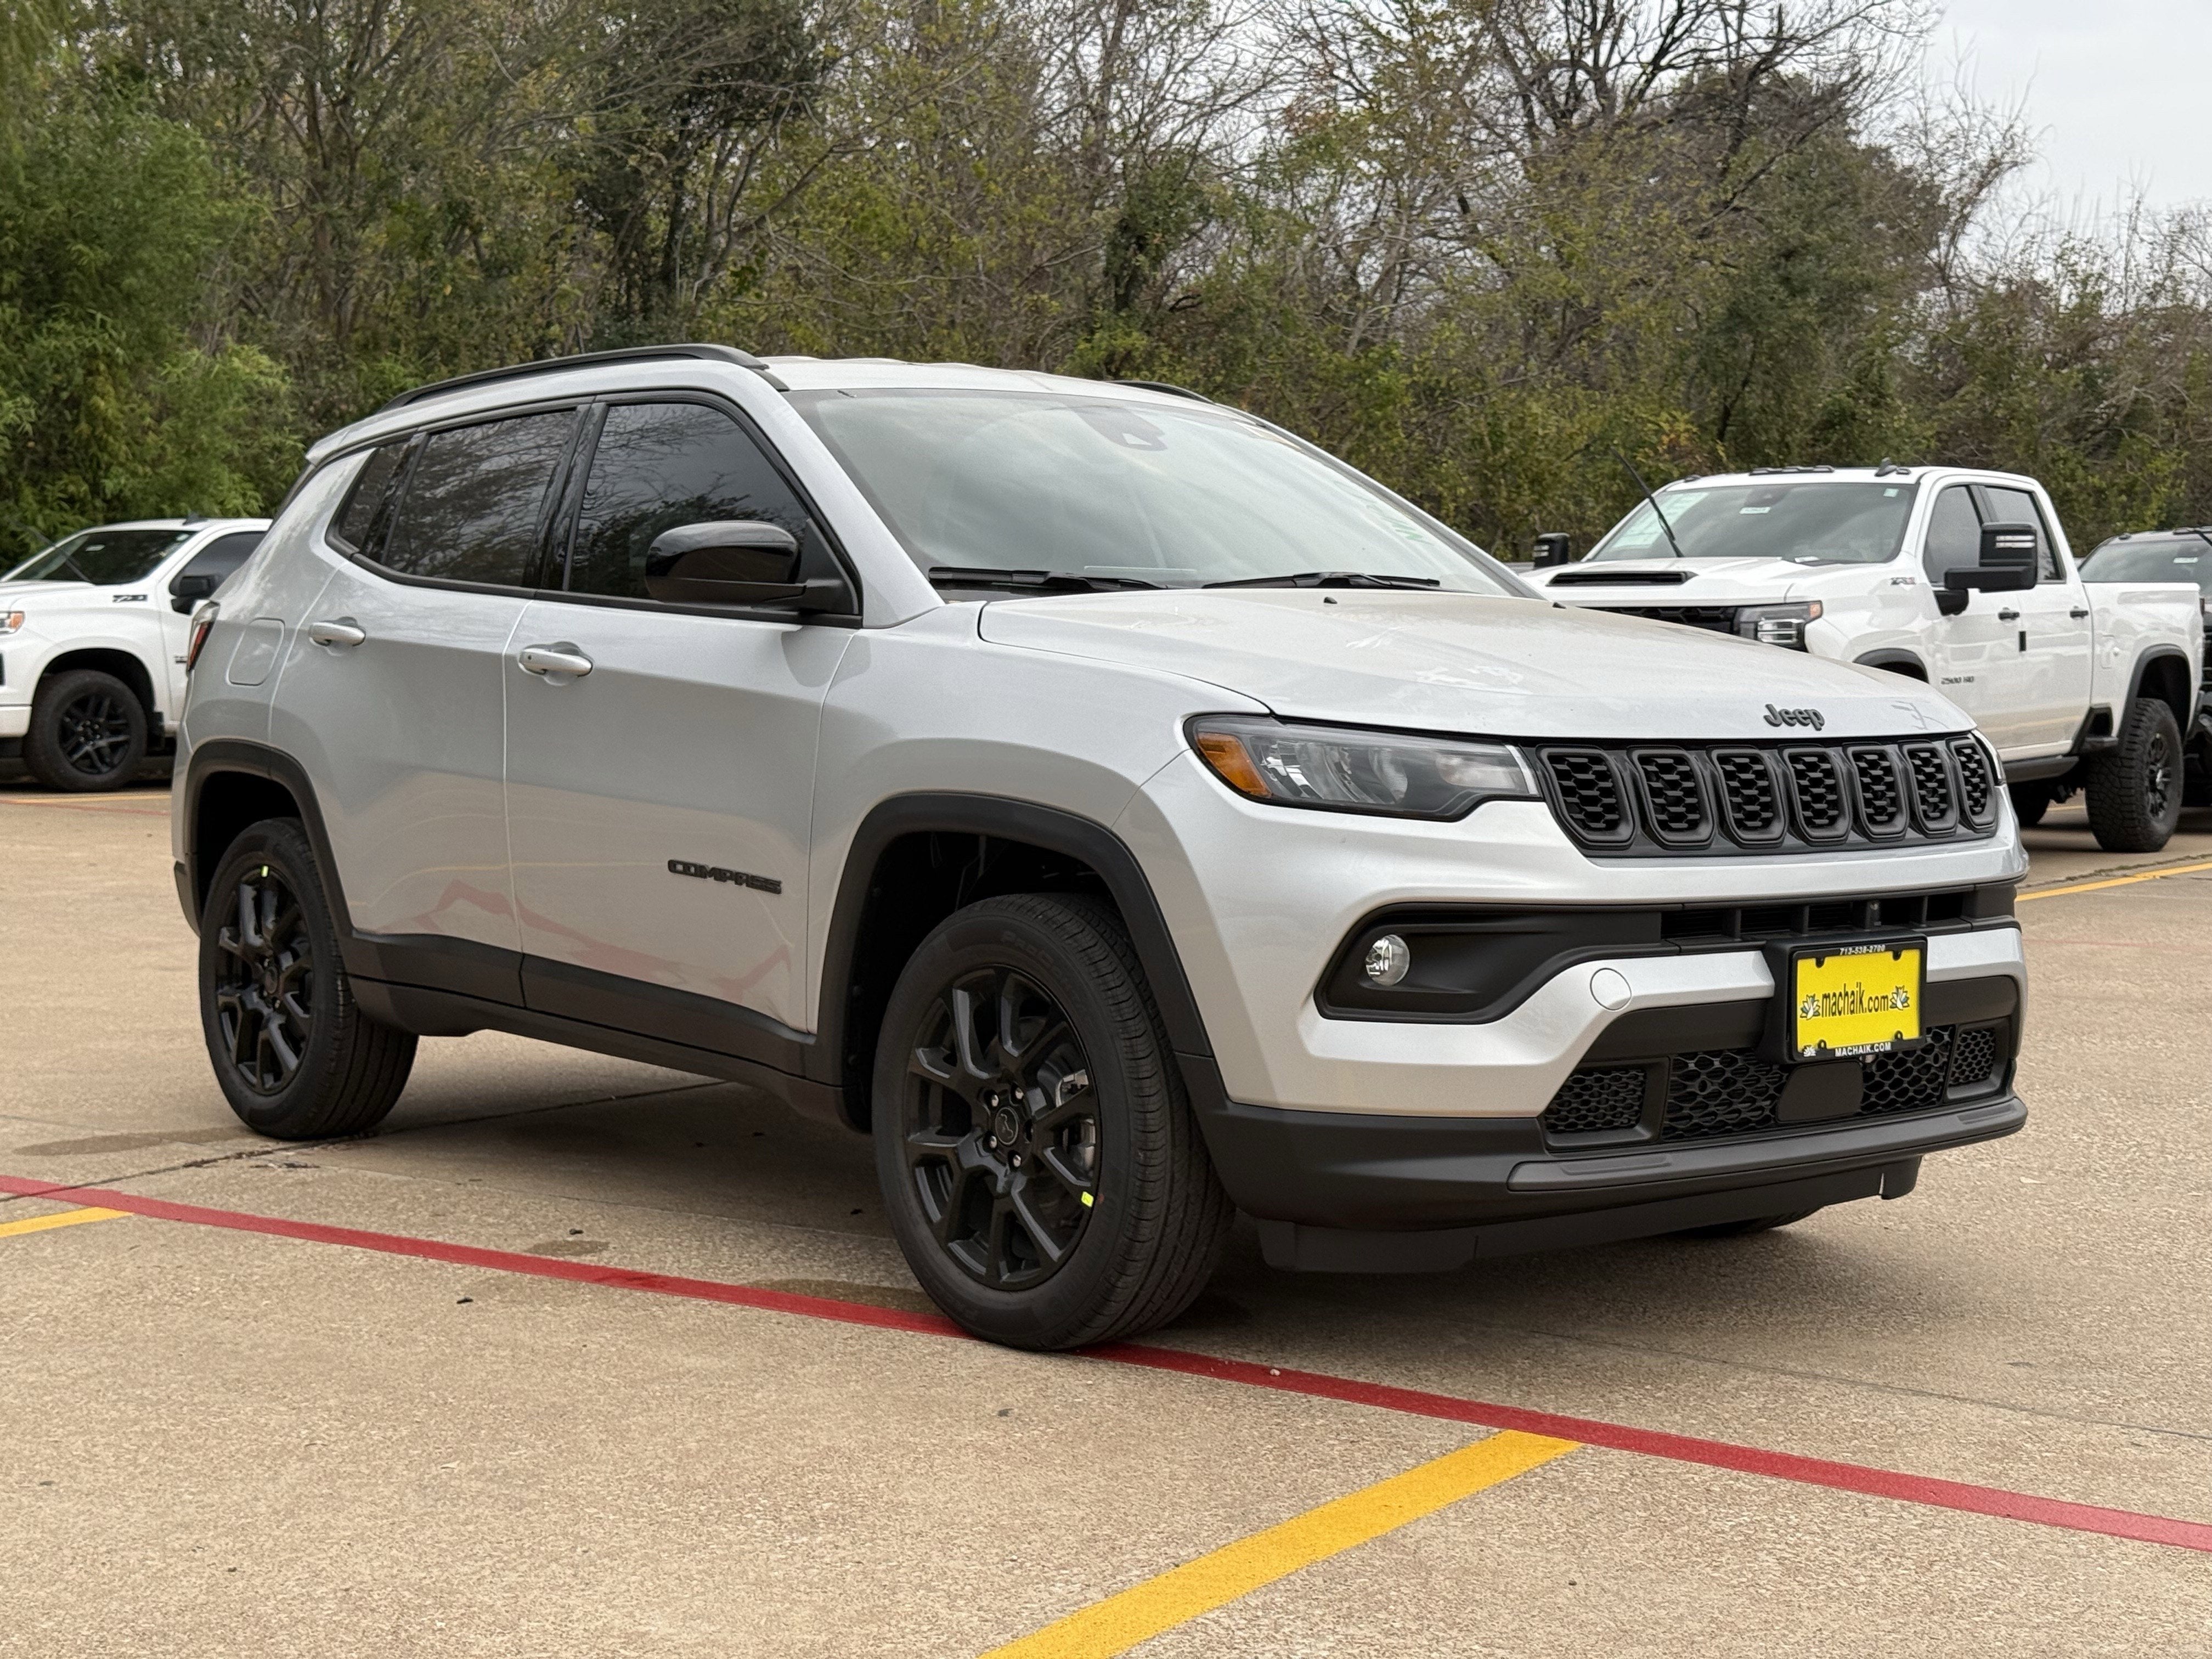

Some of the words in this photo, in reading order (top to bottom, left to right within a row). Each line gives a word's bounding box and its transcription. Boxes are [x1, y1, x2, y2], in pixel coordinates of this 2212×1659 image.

[1763, 703, 1825, 731] Jeep
[668, 859, 782, 895] COMPASS
[1821, 981, 1889, 1018] machaik.com
[1835, 1042, 1892, 1057] MACHAIK.COM
